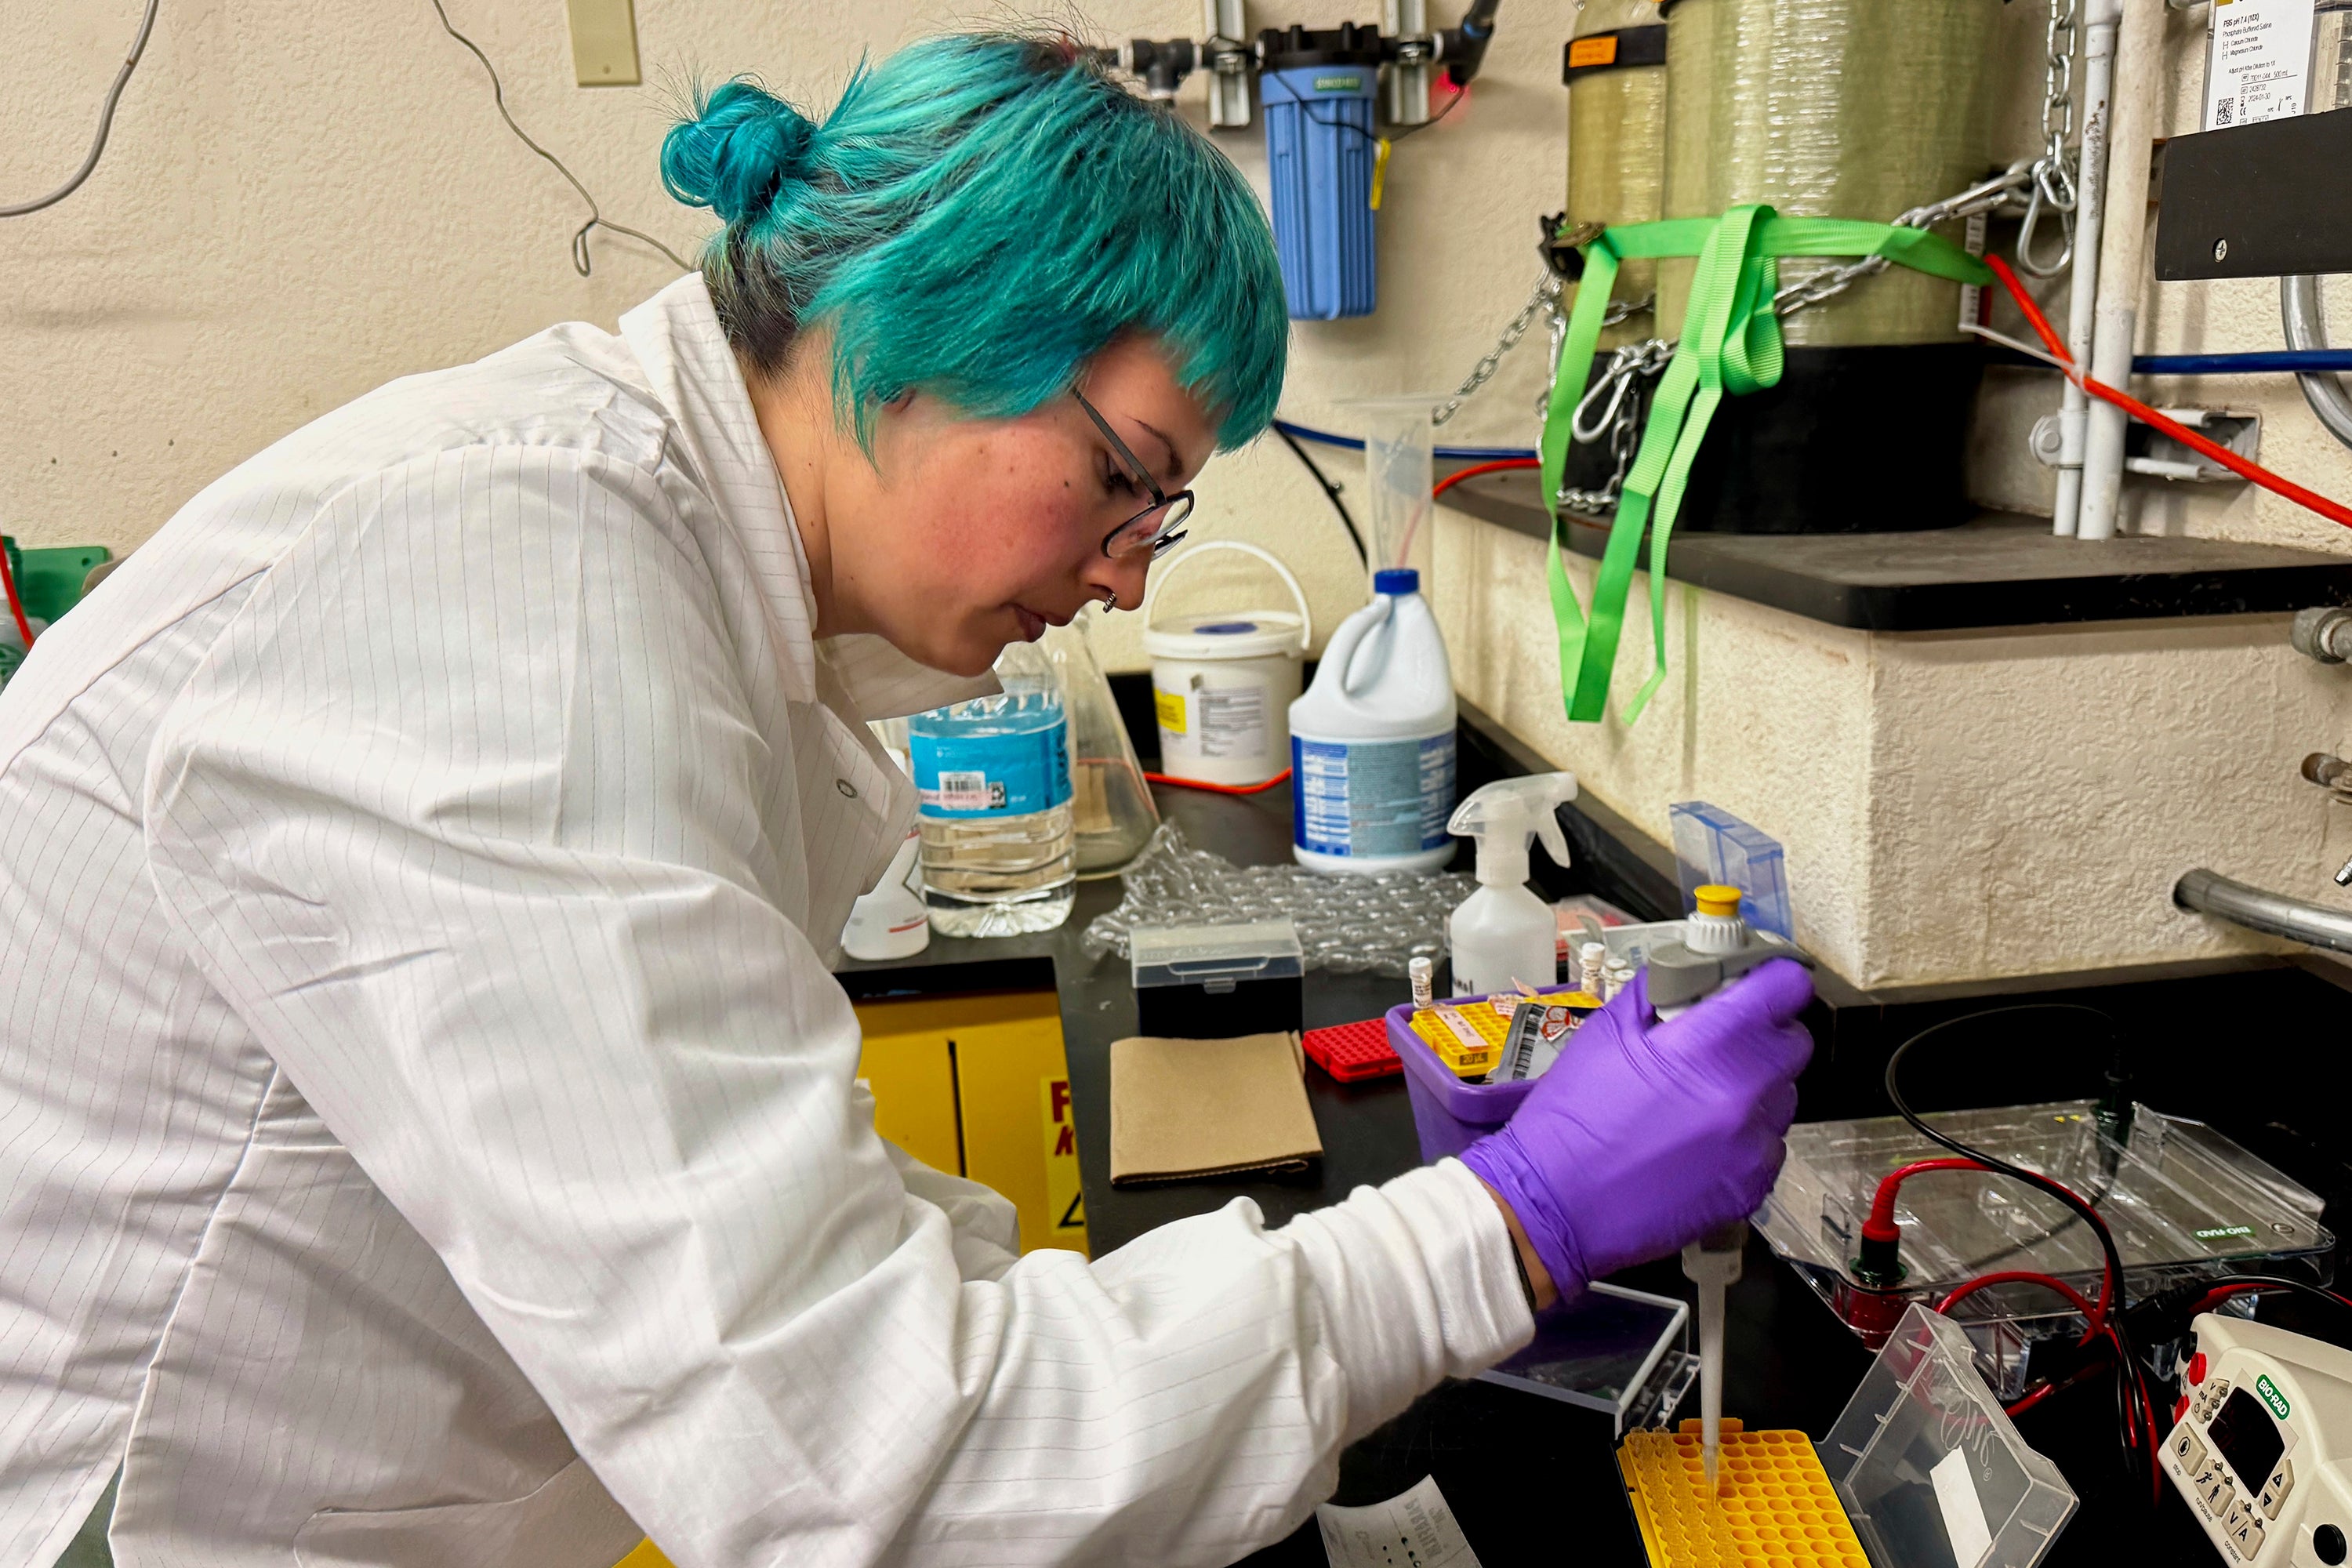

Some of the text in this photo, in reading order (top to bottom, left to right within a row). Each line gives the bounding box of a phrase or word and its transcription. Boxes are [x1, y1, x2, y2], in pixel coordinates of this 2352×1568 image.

[2223, 19, 2233, 27] PBS
[2209, 1382, 2216, 1391] V
[2198, 1390, 2209, 1403] mA
[2258, 1378, 2288, 1416] BIO-RAD
[2172, 1463, 2182, 1476] stop
[2195, 1497, 2213, 1523] run/pause
[2229, 1511, 2239, 1525] V
[2238, 1527, 2248, 1542] A
[2224, 1540, 2241, 1564] constant
